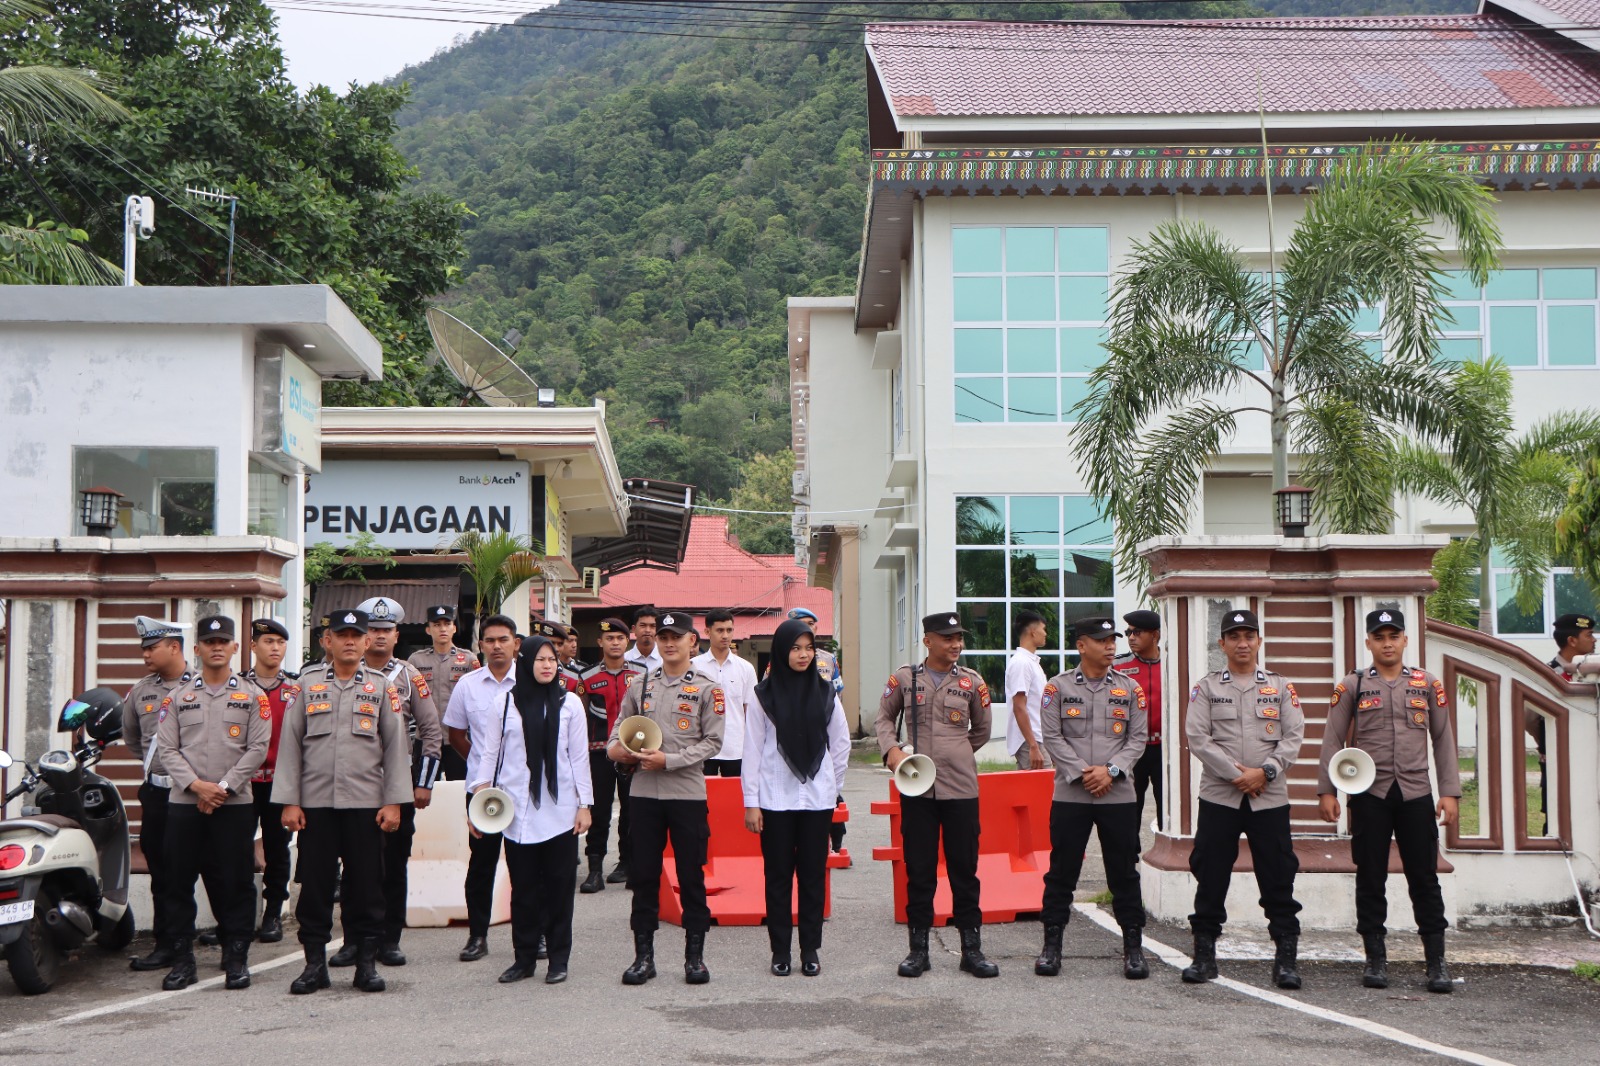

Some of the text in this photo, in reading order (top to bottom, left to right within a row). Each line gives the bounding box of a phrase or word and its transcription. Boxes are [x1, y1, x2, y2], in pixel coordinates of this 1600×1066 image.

[289, 375, 302, 414] BSI
[459, 475, 516, 485] Bank Aceh
[304, 505, 511, 534] PENJAGAAN
[677, 693, 700, 702] POLRI
[947, 688, 971, 699] POLRI
[1406, 689, 1430, 697] POLRI
[356, 694, 381, 704] POLRI
